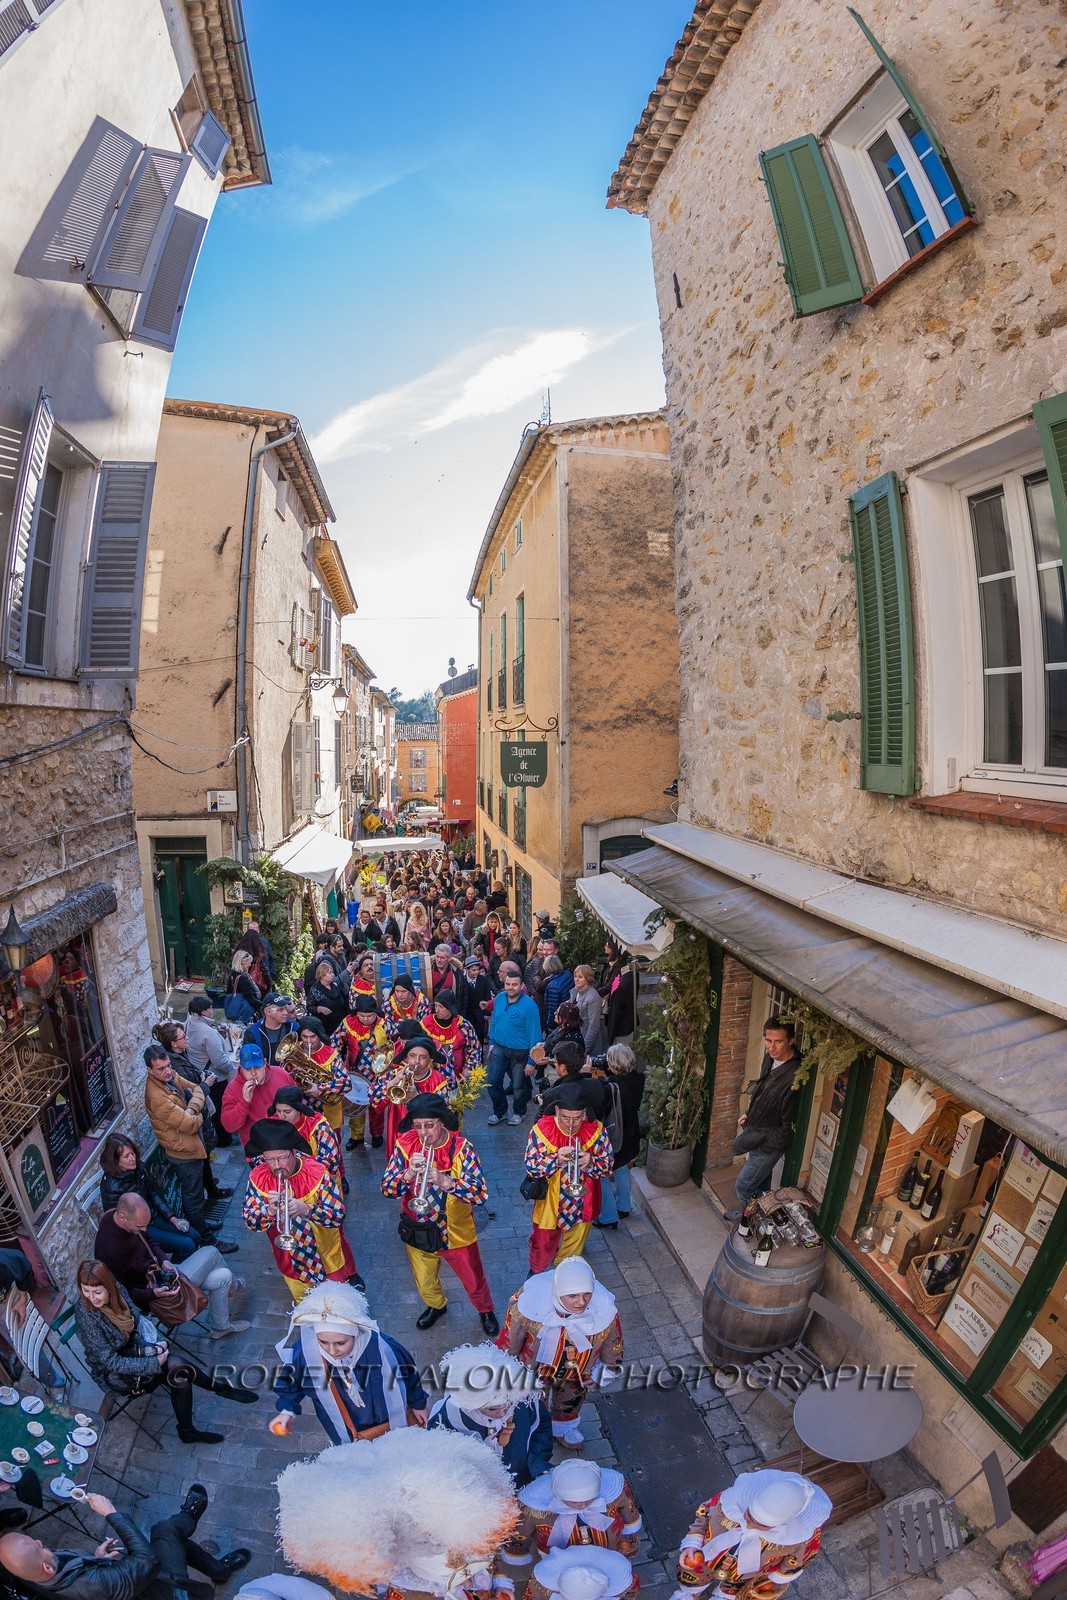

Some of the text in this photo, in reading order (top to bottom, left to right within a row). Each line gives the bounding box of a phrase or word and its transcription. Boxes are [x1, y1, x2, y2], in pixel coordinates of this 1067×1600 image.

[511, 747, 537, 758] Agence
[520, 760, 528, 770] de
[508, 773, 540, 783] l'Olivier
